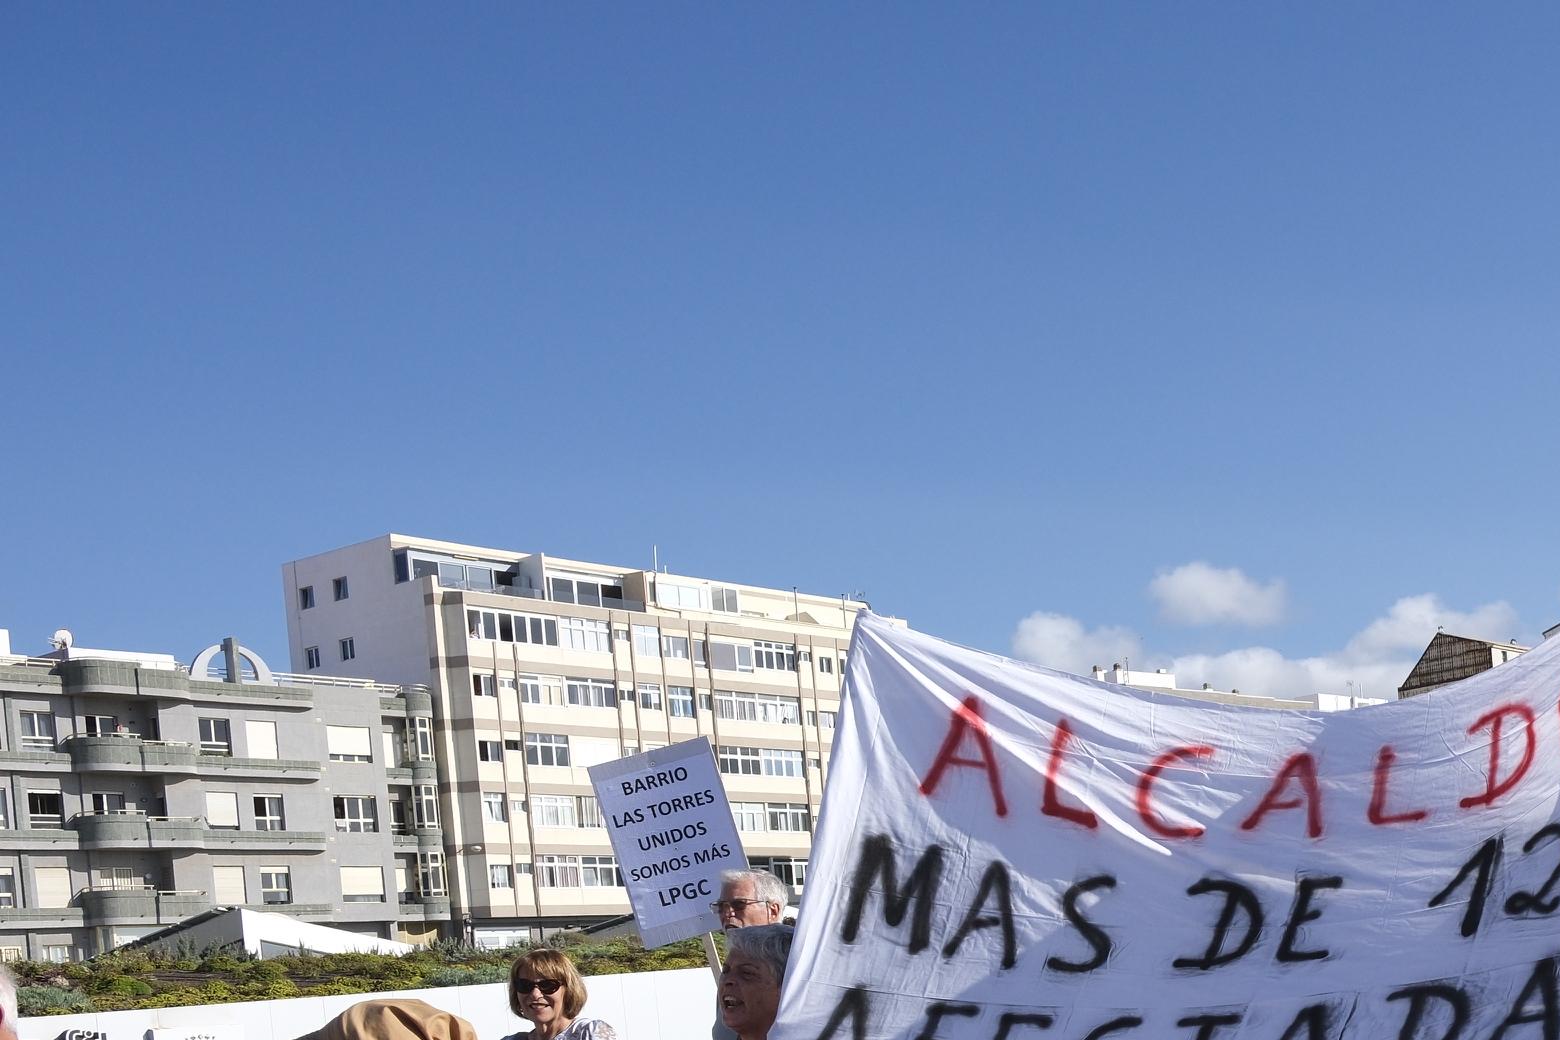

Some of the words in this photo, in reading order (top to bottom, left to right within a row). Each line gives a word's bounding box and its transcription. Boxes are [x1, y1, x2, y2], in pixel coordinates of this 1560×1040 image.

[621, 767, 688, 796] BARRIO
[612, 809, 644, 828] LAS
[647, 790, 714, 818] TORRES
[638, 821, 707, 850] UNIDOS
[631, 855, 690, 881] SOMOS
[694, 843, 731, 865] MÁS
[658, 879, 711, 906] LPGC
[840, 833, 1117, 972] MAS
[1172, 874, 1344, 970] DE
